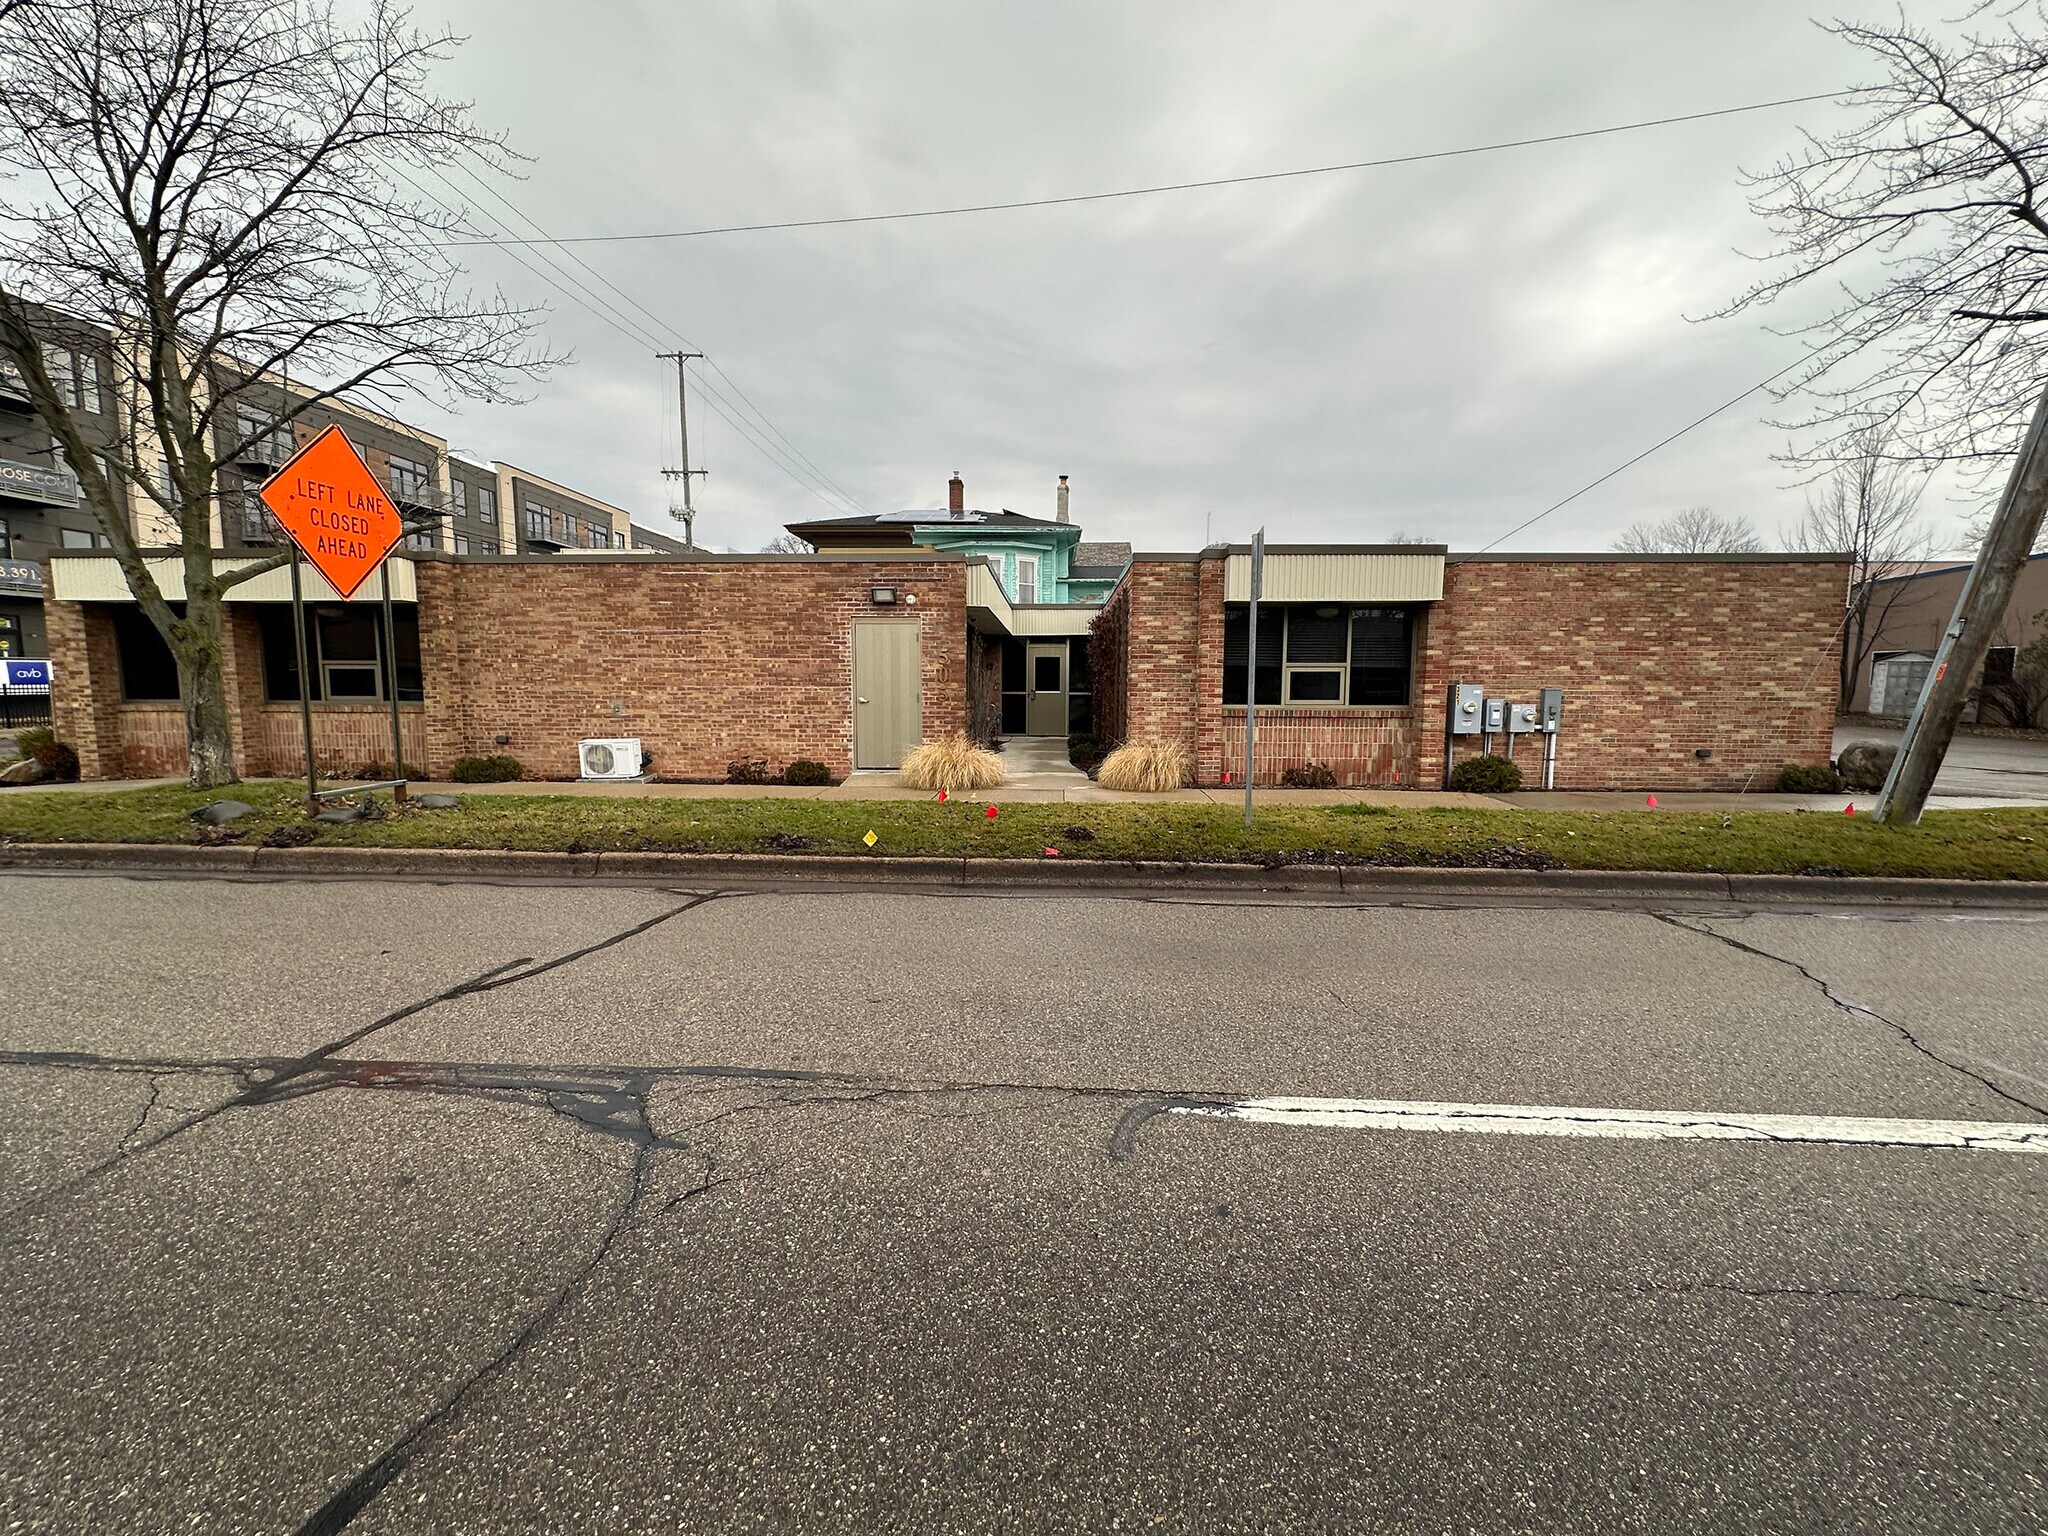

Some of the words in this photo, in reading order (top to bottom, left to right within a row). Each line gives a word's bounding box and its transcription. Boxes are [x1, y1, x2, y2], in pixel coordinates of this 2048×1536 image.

[297, 477, 335, 503] LEFT
[347, 490, 385, 515] LANE
[310, 507, 369, 536] CLOSED
[317, 534, 367, 559] AHEAD
[16, 667, 42, 678] avb
